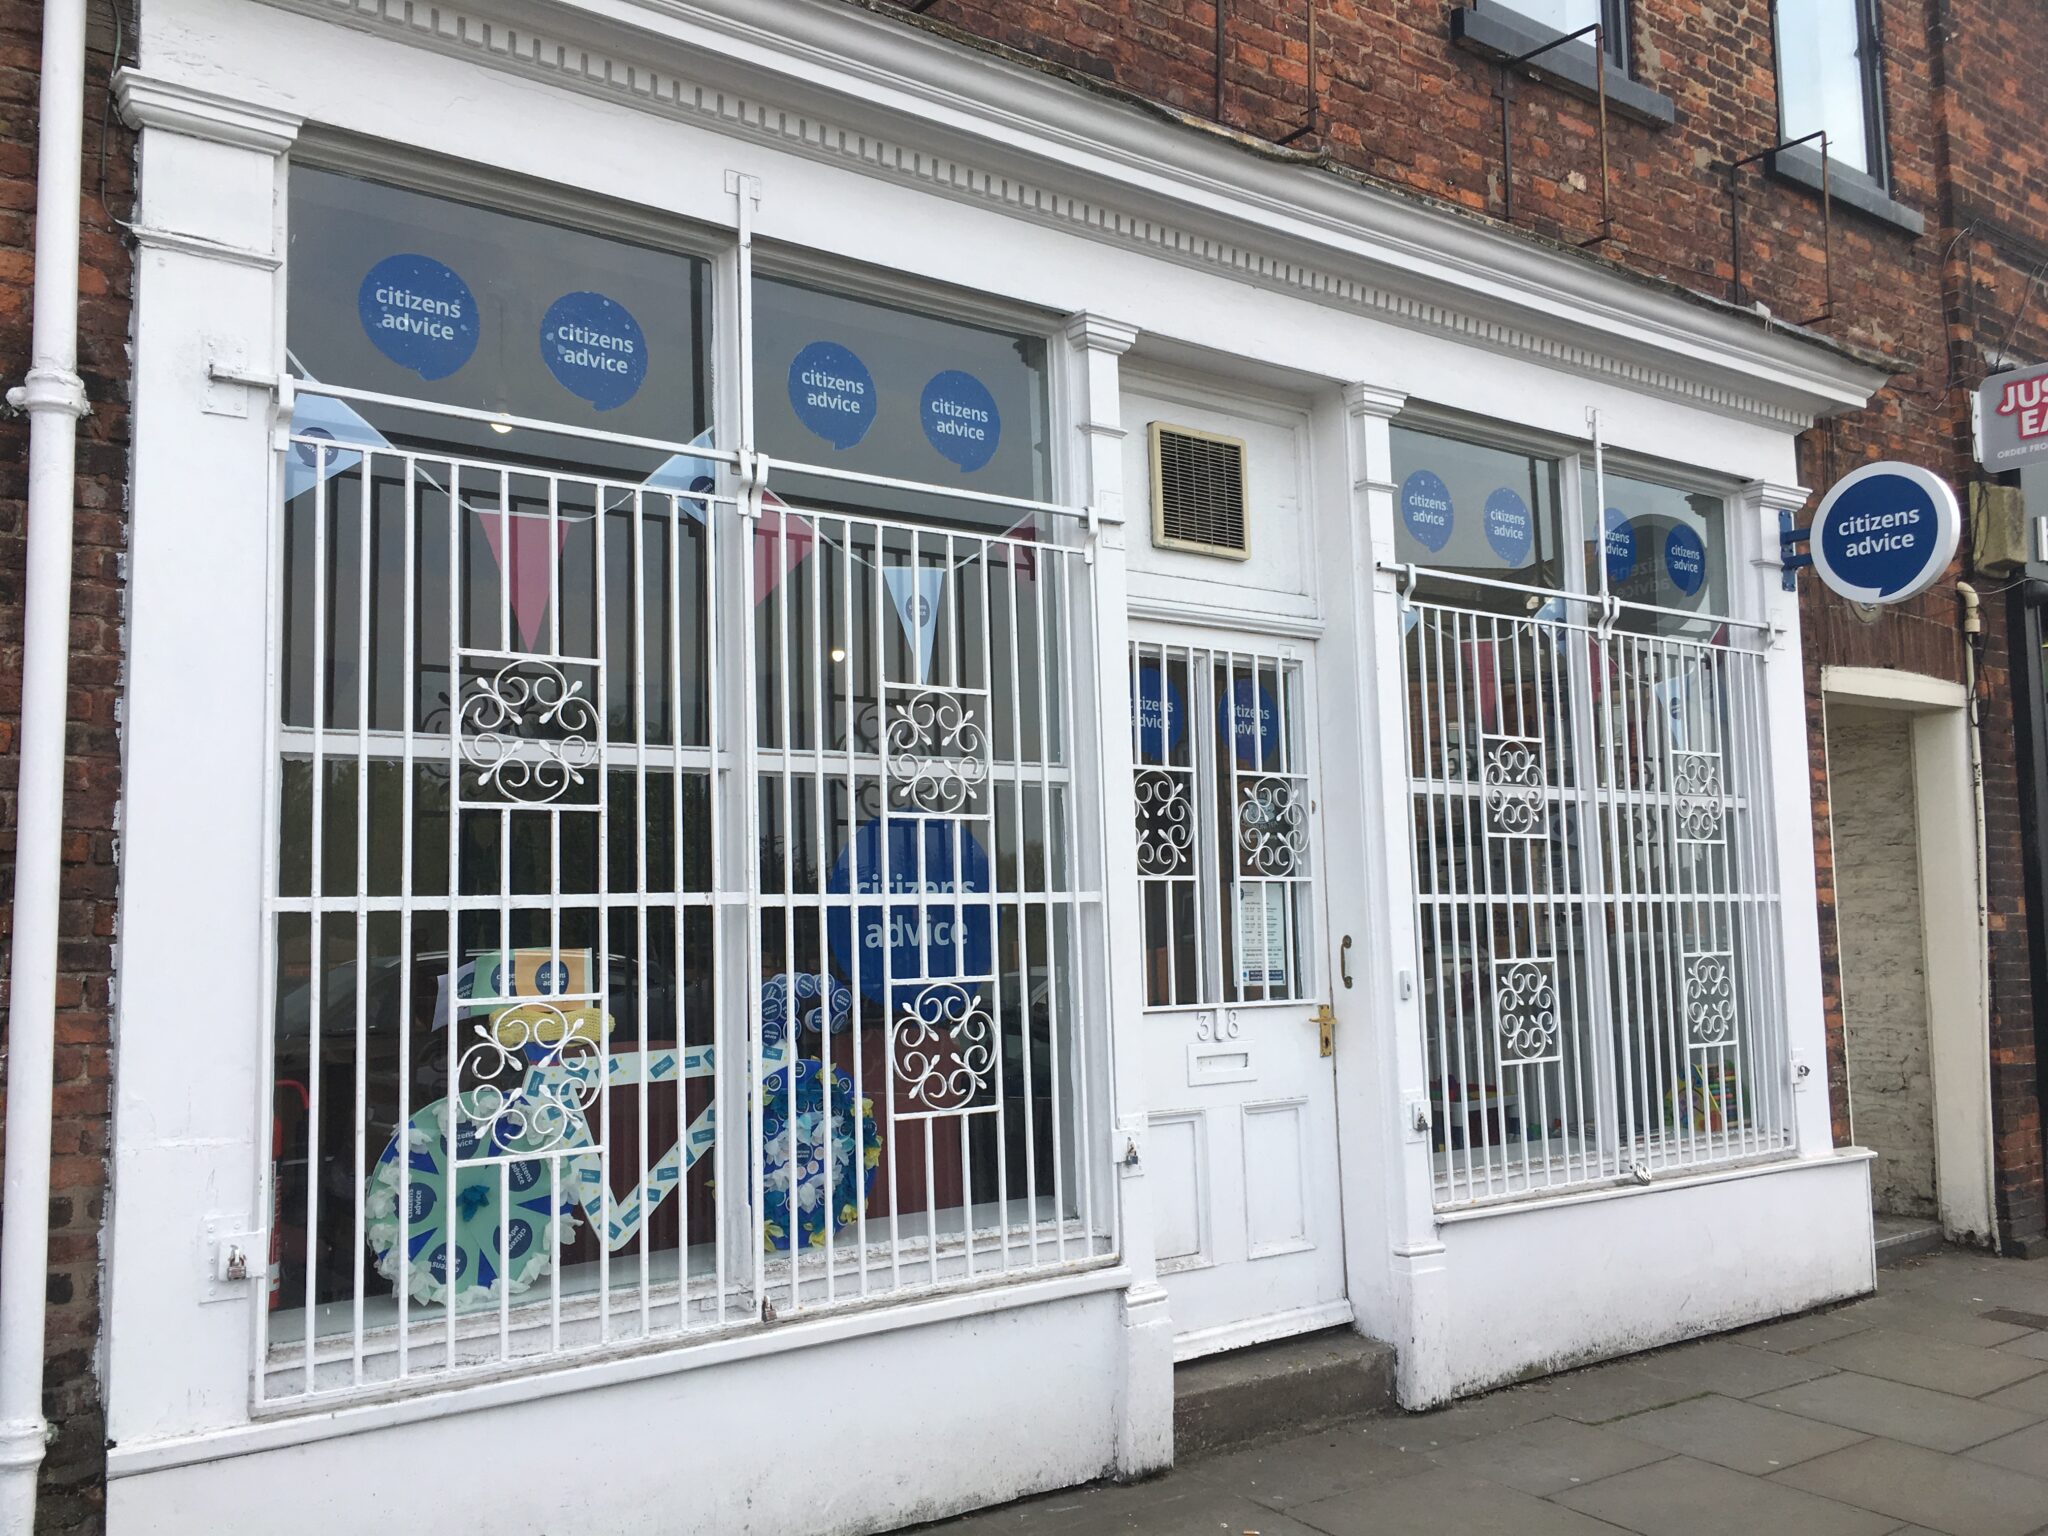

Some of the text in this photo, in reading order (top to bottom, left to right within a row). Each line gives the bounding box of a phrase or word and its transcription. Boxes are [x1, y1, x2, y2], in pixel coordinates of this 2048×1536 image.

[375, 286, 461, 319] citizens
[381, 311, 455, 341] advice
[558, 323, 634, 354] citizens
[564, 346, 629, 374] advice
[801, 370, 865, 395] citizens
[807, 390, 861, 413] advice
[931, 398, 989, 423] citizens
[936, 418, 985, 441] advice
[1997, 442, 2048, 459] ORDER FRO
[1409, 494, 1447, 512] citizens
[1412, 510, 1445, 526] advice
[1490, 509, 1526, 526] citizens
[1838, 507, 1920, 536] citizens
[1494, 525, 1524, 540] advice
[1605, 529, 1630, 544] tizens
[1606, 543, 1628, 557] dvice
[1671, 544, 1700, 560] citizens
[1846, 532, 1915, 558] advice
[1674, 559, 1699, 573] advice
[1233, 703, 1270, 720] tizens
[1234, 720, 1268, 736] dvie
[865, 914, 968, 948] advice
[509, 1228, 526, 1250] citizen
